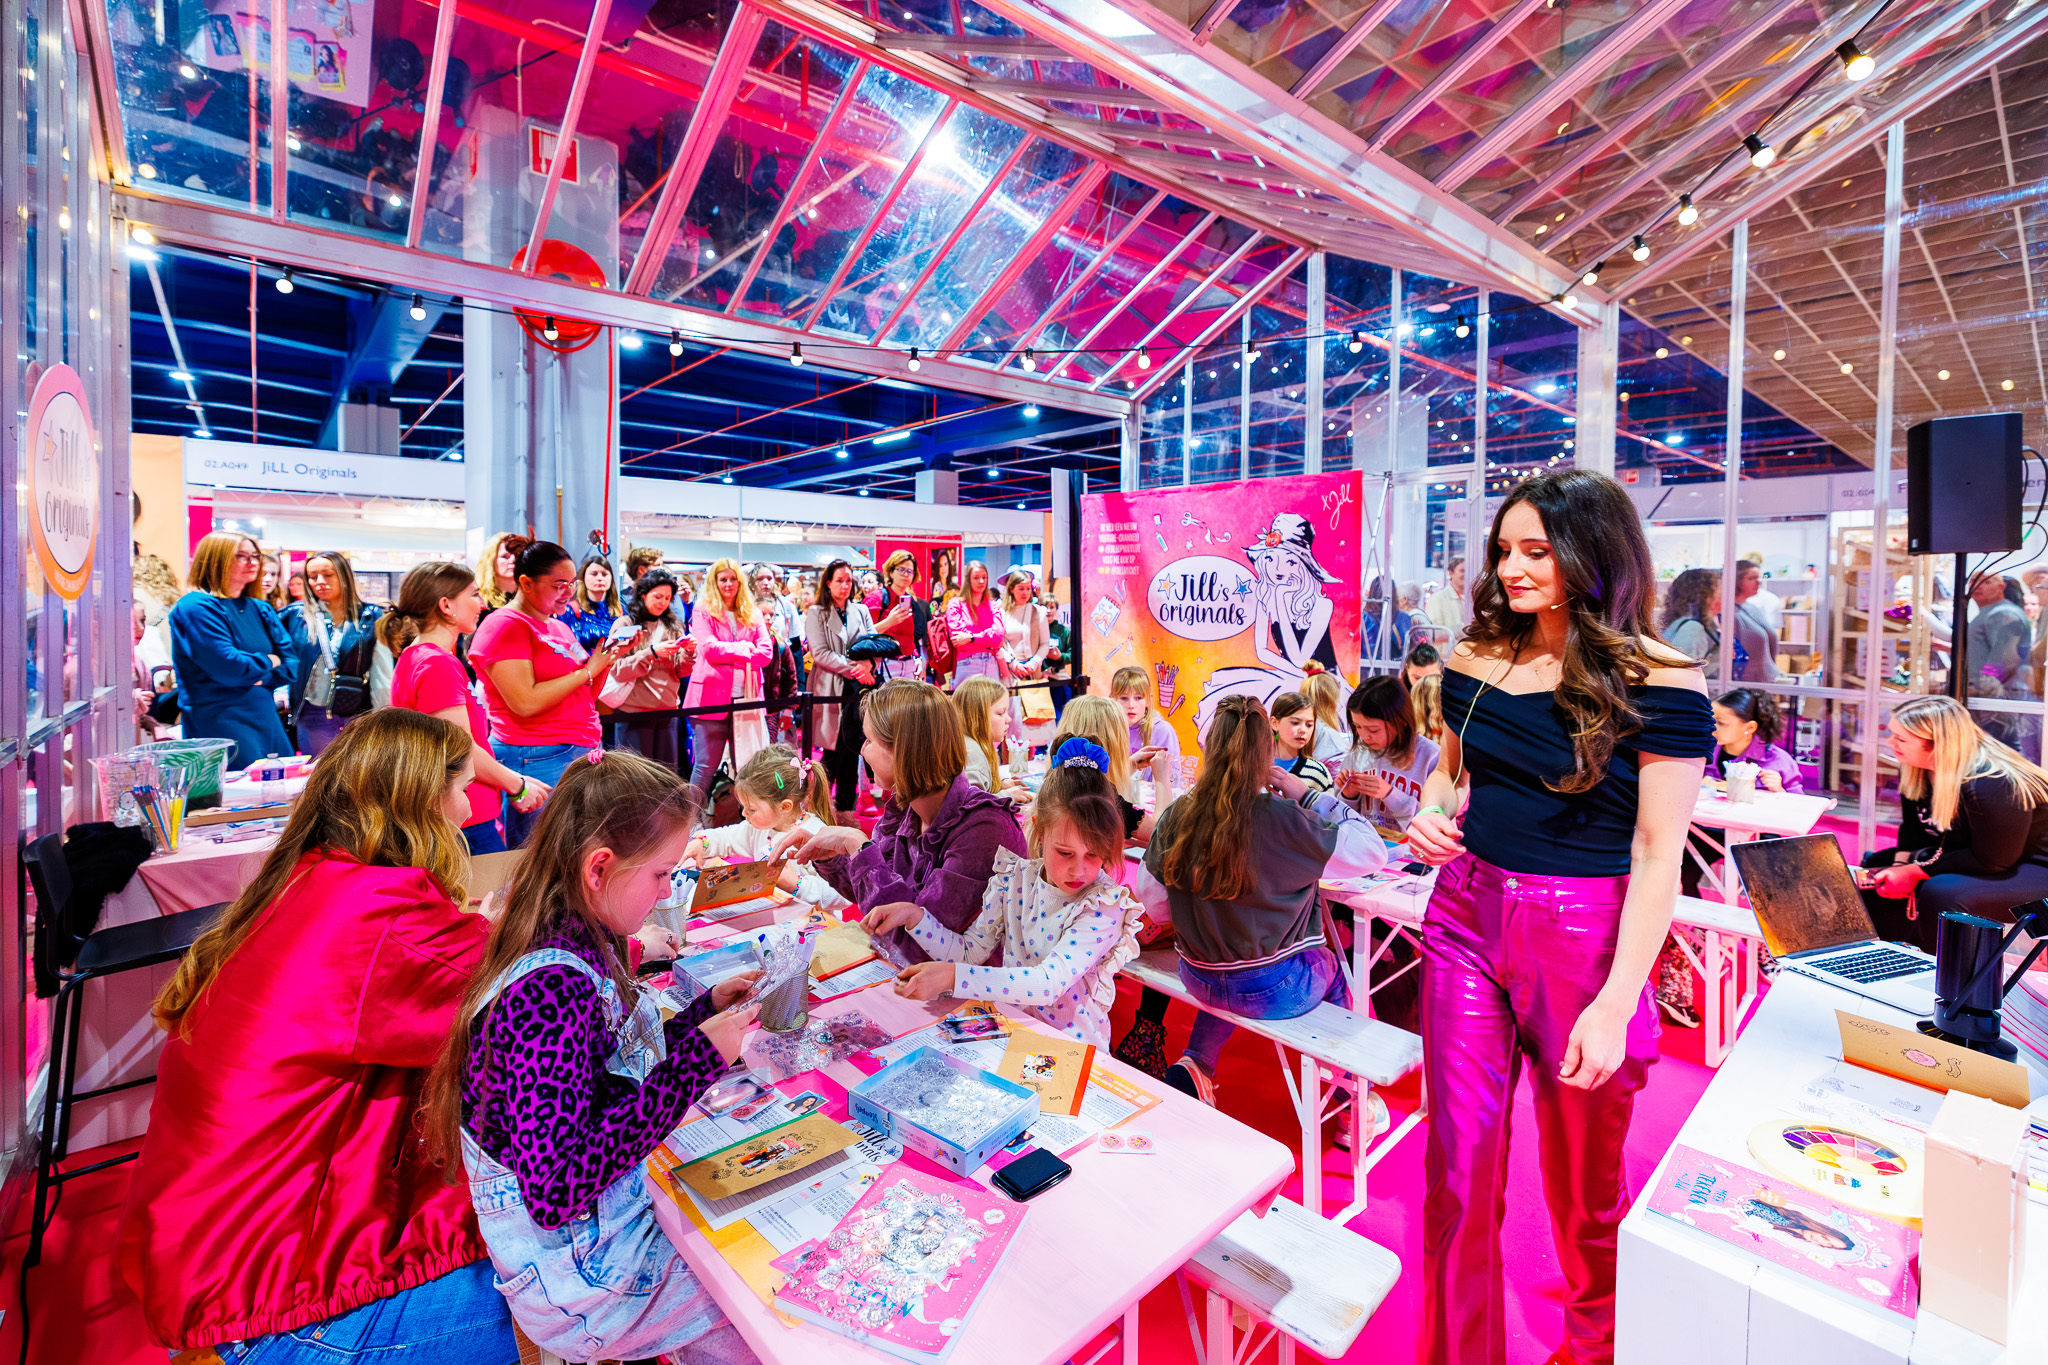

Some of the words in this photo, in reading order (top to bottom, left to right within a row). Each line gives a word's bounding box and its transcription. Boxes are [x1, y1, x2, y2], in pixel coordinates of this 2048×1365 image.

[294, 462, 358, 480] Originals
[44, 490, 91, 543] Originals
[1175, 571, 1229, 602] Jill's
[1159, 602, 1248, 626] Originals
[854, 1140, 882, 1162] inals
[1687, 1172, 1717, 1208] TEKENEN
